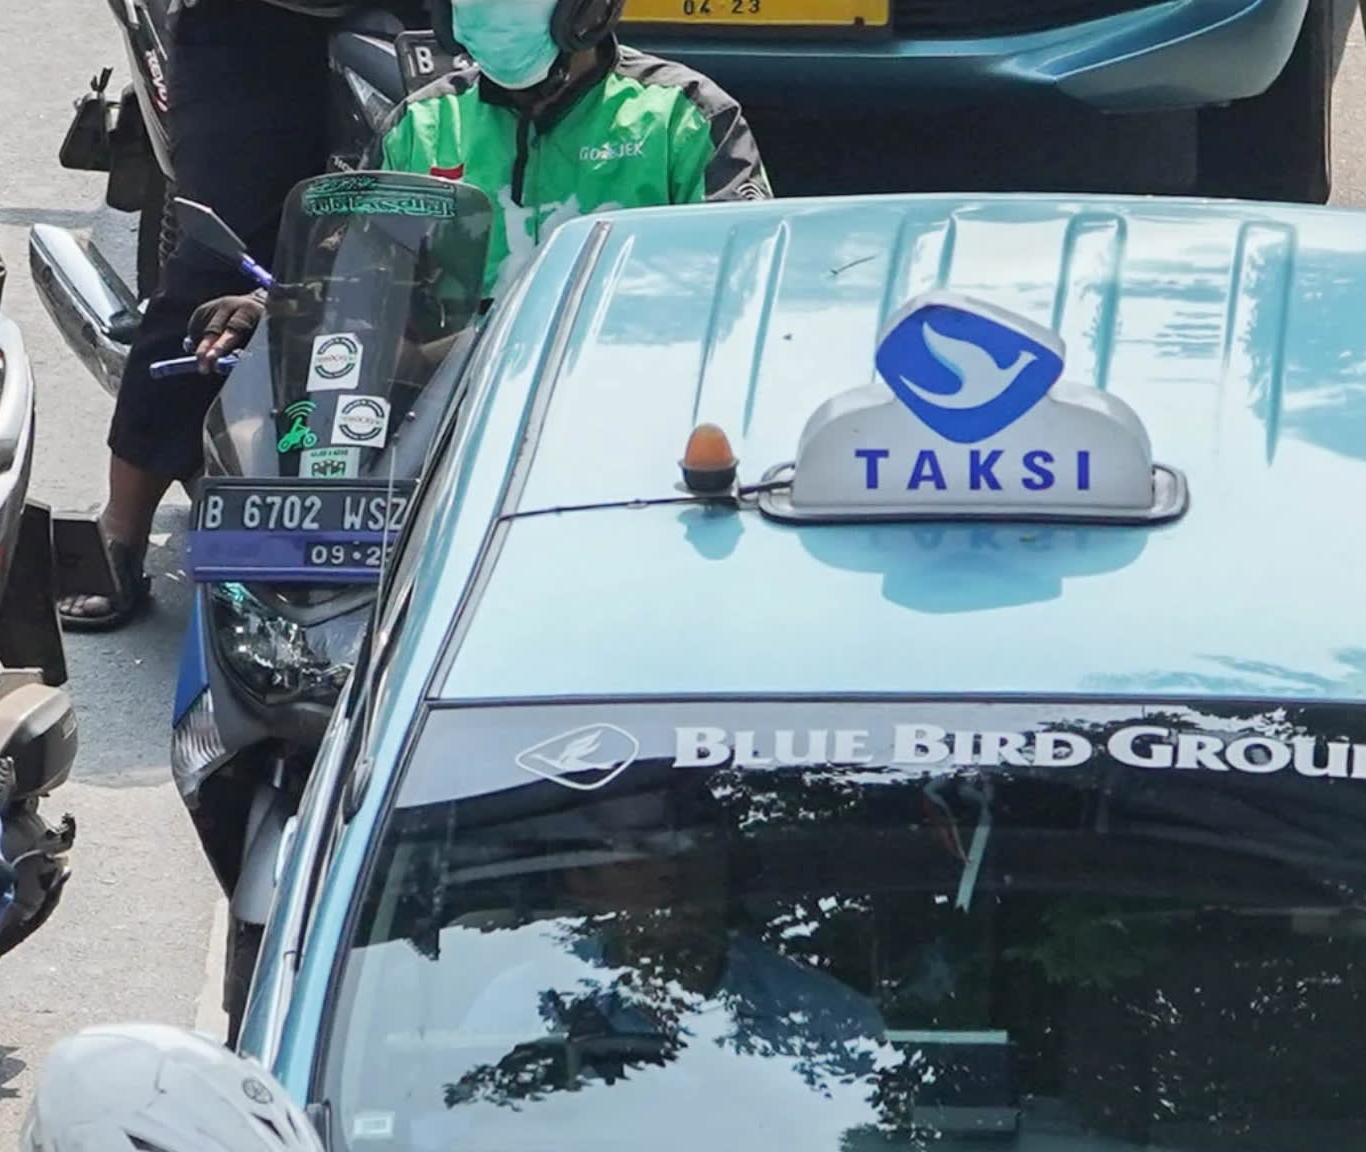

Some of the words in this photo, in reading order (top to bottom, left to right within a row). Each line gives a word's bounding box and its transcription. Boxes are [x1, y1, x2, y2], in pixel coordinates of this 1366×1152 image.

[416, 46, 434, 74] B
[854, 448, 1091, 491] TAKSI
[205, 495, 224, 528] B
[243, 495, 322, 529] 6702
[343, 496, 407, 531] WSZ
[673, 726, 873, 767] BLUE
[892, 723, 1093, 767] BIRD
